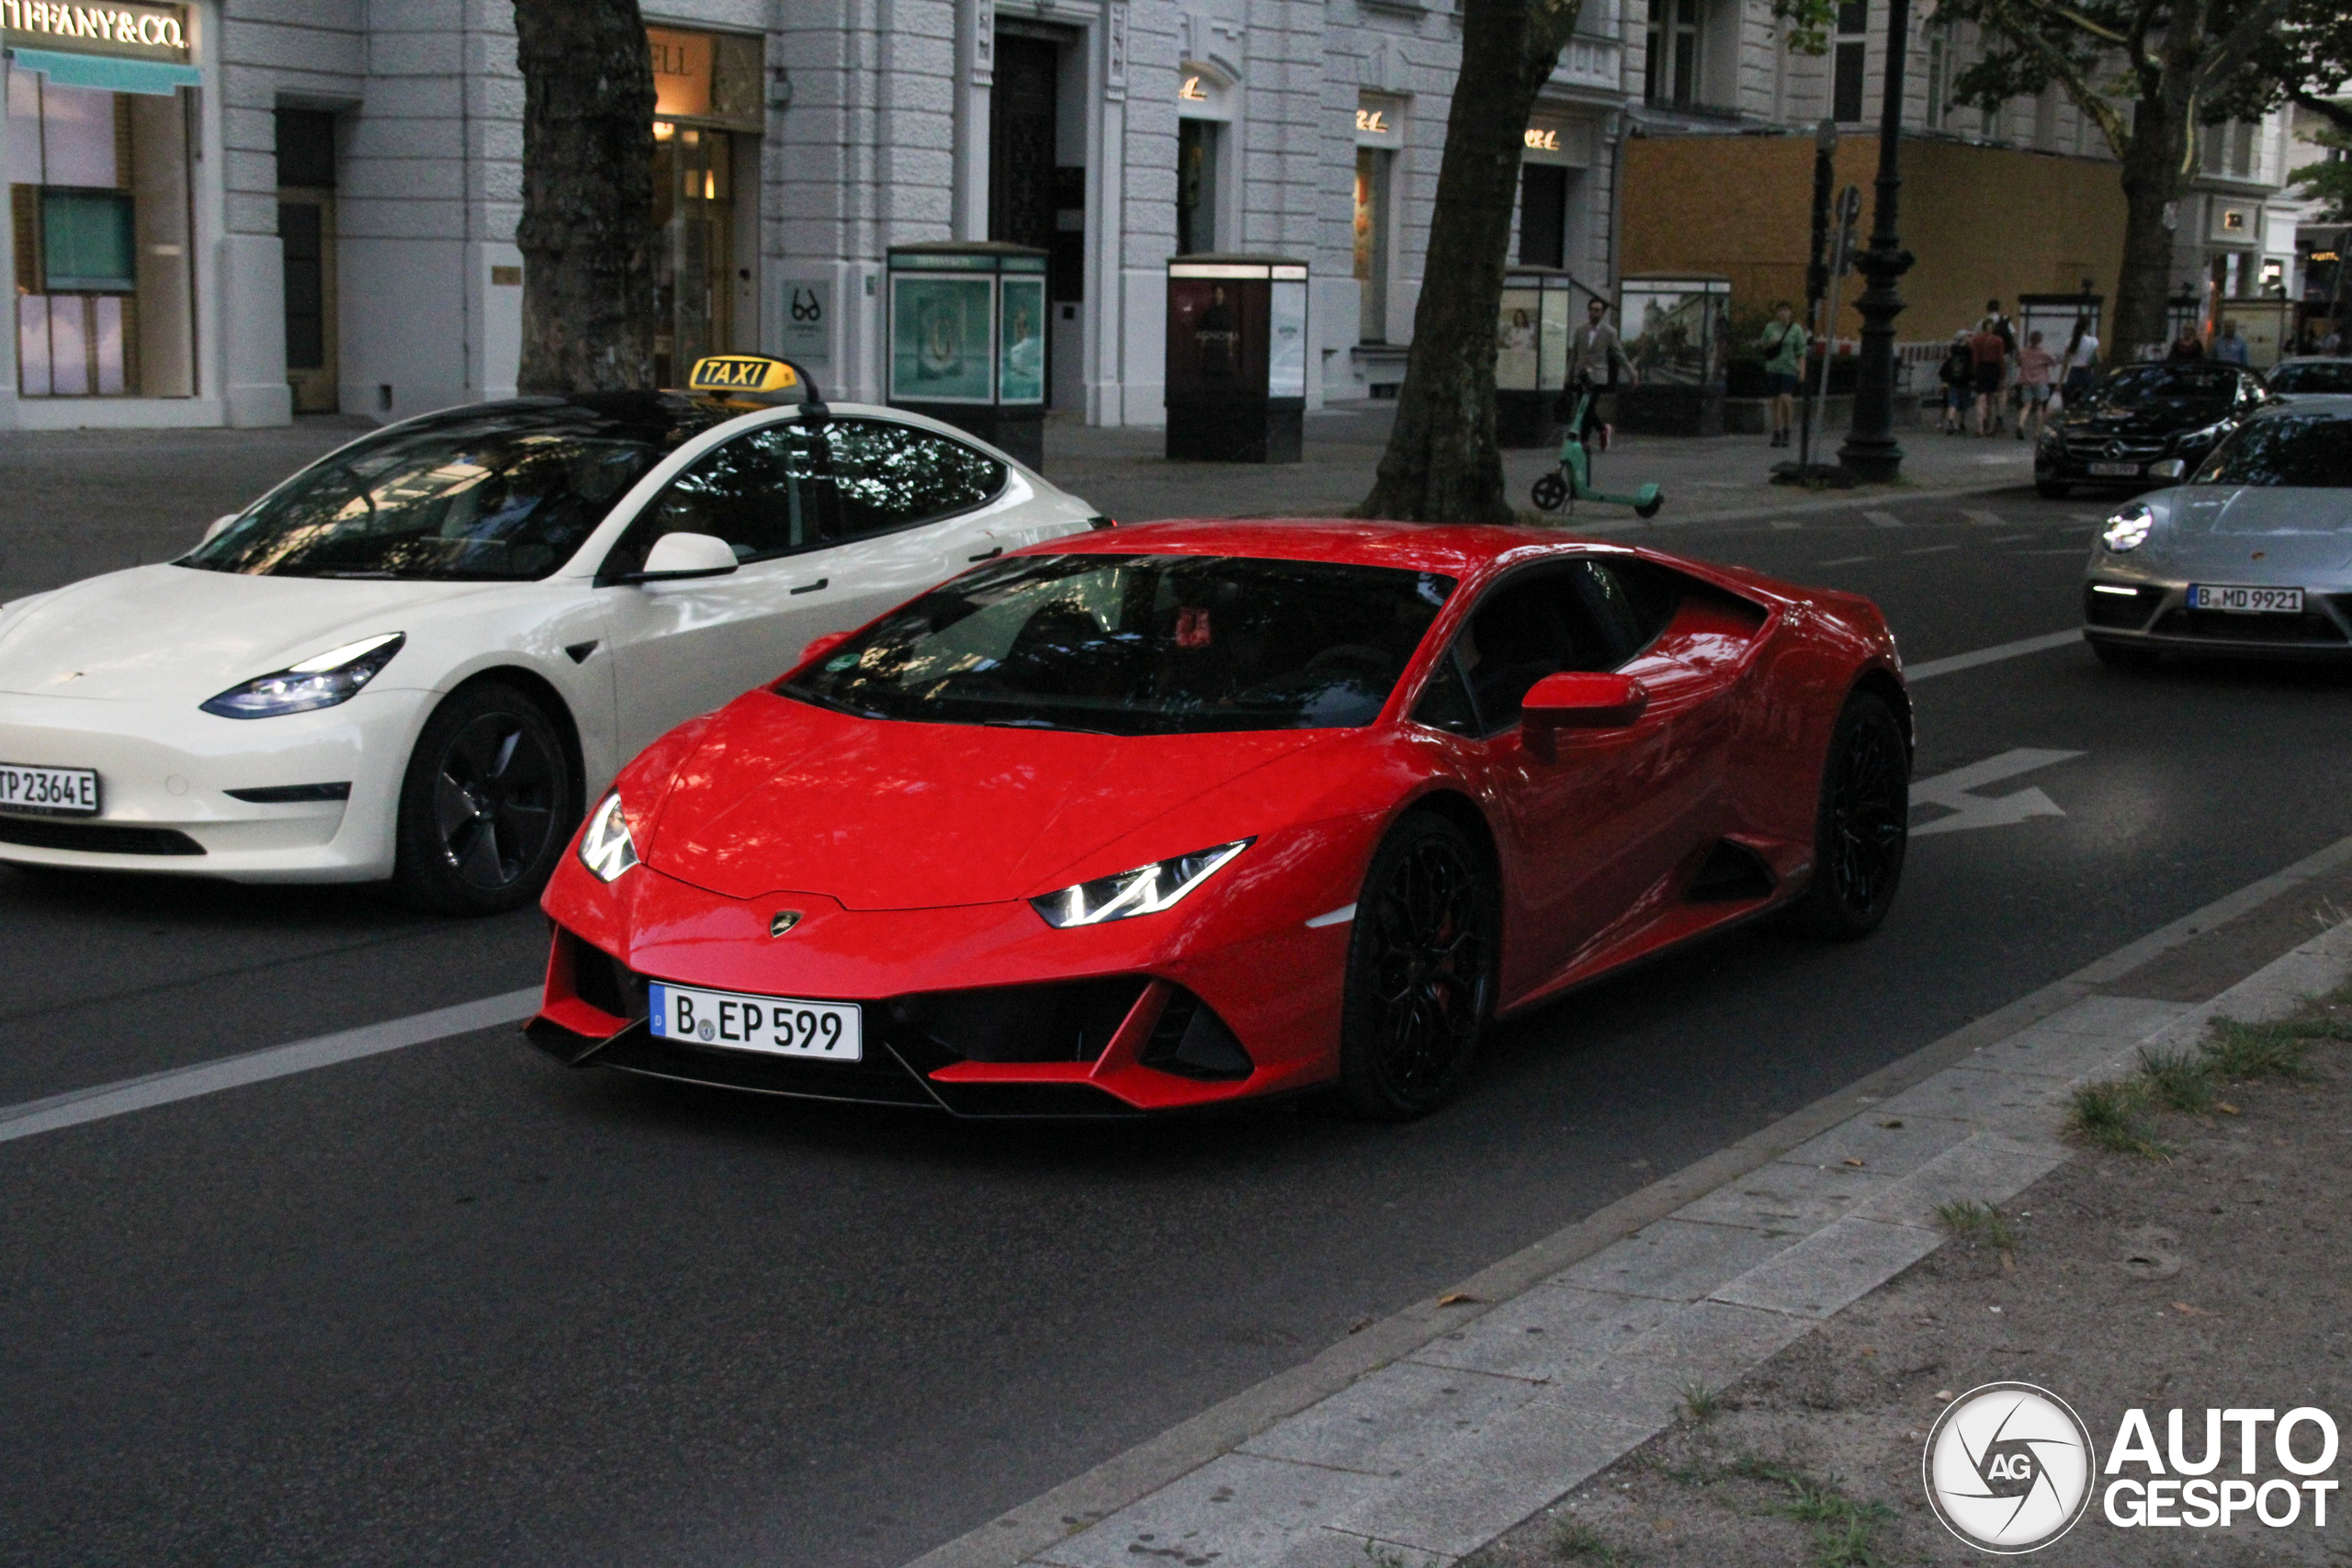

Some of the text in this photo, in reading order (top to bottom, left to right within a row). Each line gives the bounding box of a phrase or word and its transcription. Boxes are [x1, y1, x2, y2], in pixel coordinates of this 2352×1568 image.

[703, 362, 763, 385] TAXI
[2199, 589, 2298, 610] B MD 9921
[677, 995, 695, 1034] B
[719, 1000, 763, 1042] EP
[774, 1007, 842, 1051] 599
